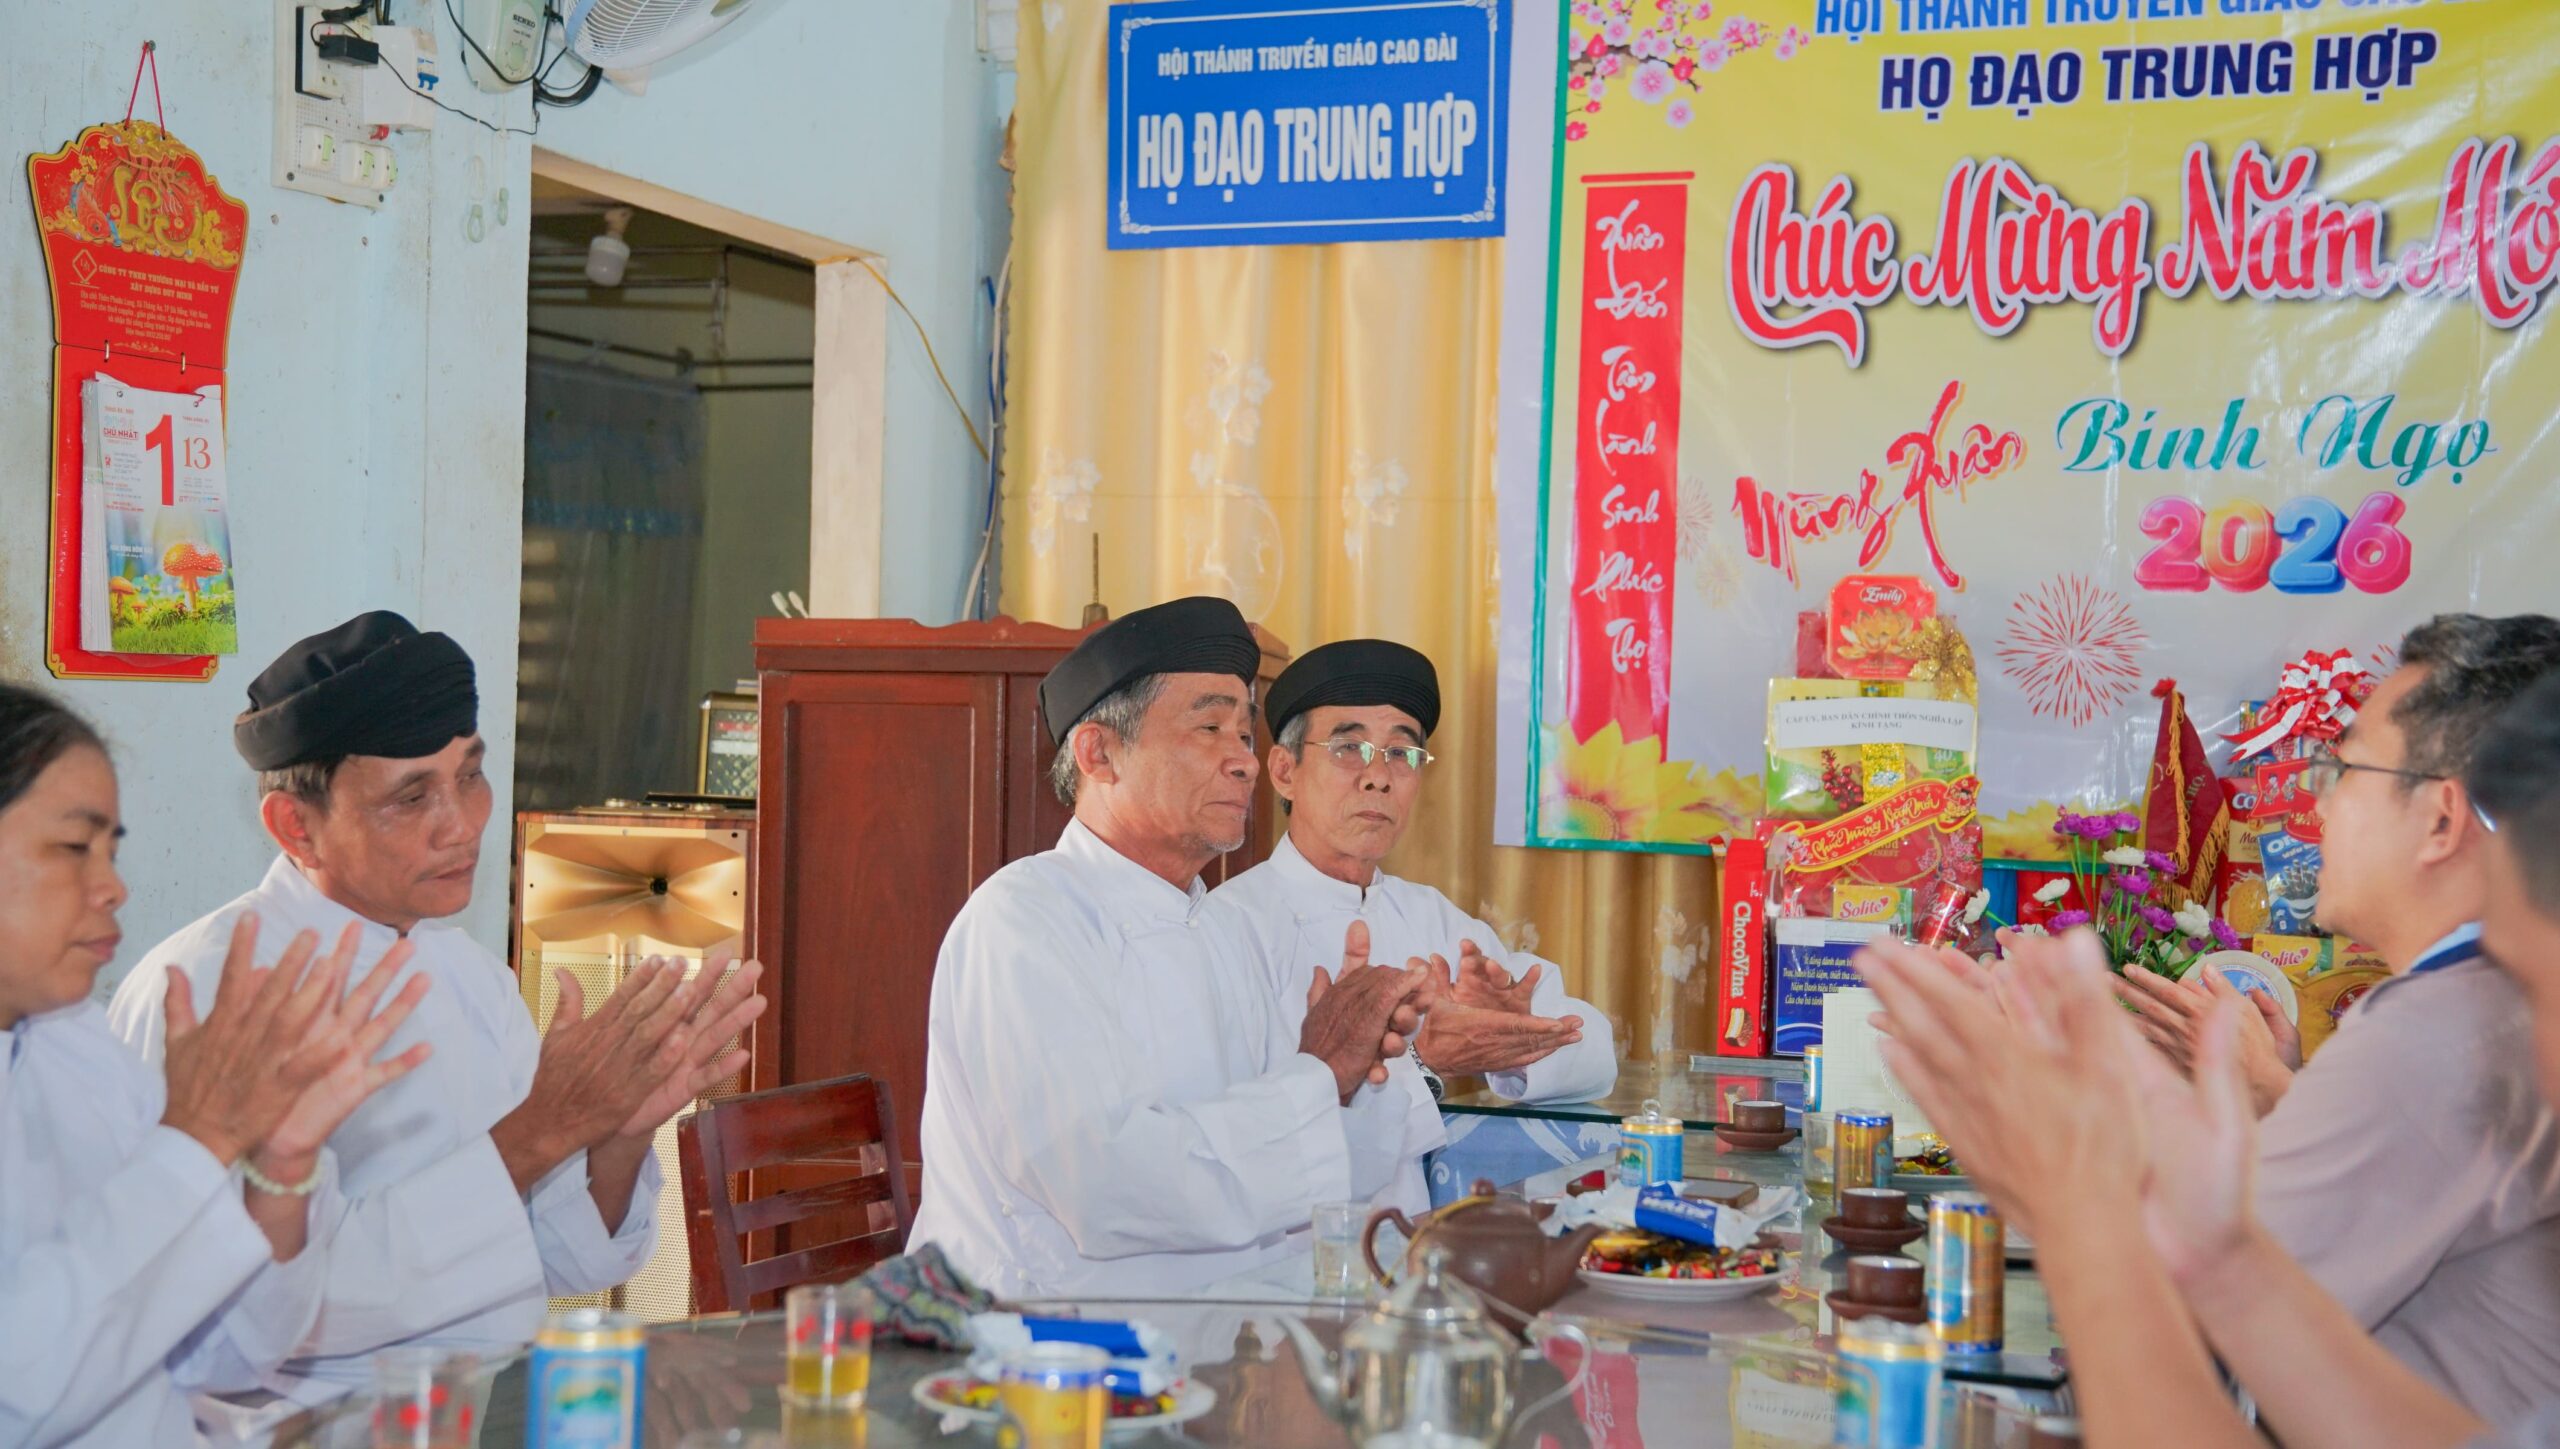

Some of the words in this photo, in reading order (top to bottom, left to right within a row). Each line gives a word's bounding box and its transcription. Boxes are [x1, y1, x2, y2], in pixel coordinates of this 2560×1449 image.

[1158, 48, 1189, 80] HỘI
[1193, 44, 1253, 74] THÁNH
[1258, 37, 1328, 72] TRUYỀN
[1333, 38, 1377, 68] GIÁO
[1382, 39, 1419, 65] CAO
[1424, 32, 1457, 62] ĐÀI
[1881, 56, 1951, 119] HỌ
[1969, 52, 2081, 116] ĐẠO
[2101, 41, 2293, 101] TRUNG
[2313, 28, 2438, 101] HỢP
[1138, 112, 1184, 204] HỌ
[1193, 109, 1265, 202] ĐẠO
[1274, 103, 1392, 183] TRUNG
[1403, 92, 1477, 194] HỢP
[1596, 199, 1664, 275] Xuân
[1728, 166, 1896, 362] Chúc
[1907, 159, 2146, 349] Mừng
[2163, 142, 2391, 294] Năm
[2402, 143, 2560, 320] Mớ
[1595, 278, 1667, 320] Đến
[146, 414, 174, 506] 1
[184, 436, 212, 470] 13
[2298, 393, 2498, 487] Ngọ
[1601, 484, 1660, 530] Sinh
[1886, 380, 2021, 587] Xuân
[2134, 491, 2412, 594] 2026
[1862, 587, 1902, 605] Emily
[1606, 617, 1647, 674] Thọ
[1840, 902, 1882, 919] Solite
[1731, 901, 1752, 998] ChocoVina
[2261, 950, 2301, 967] Solite
